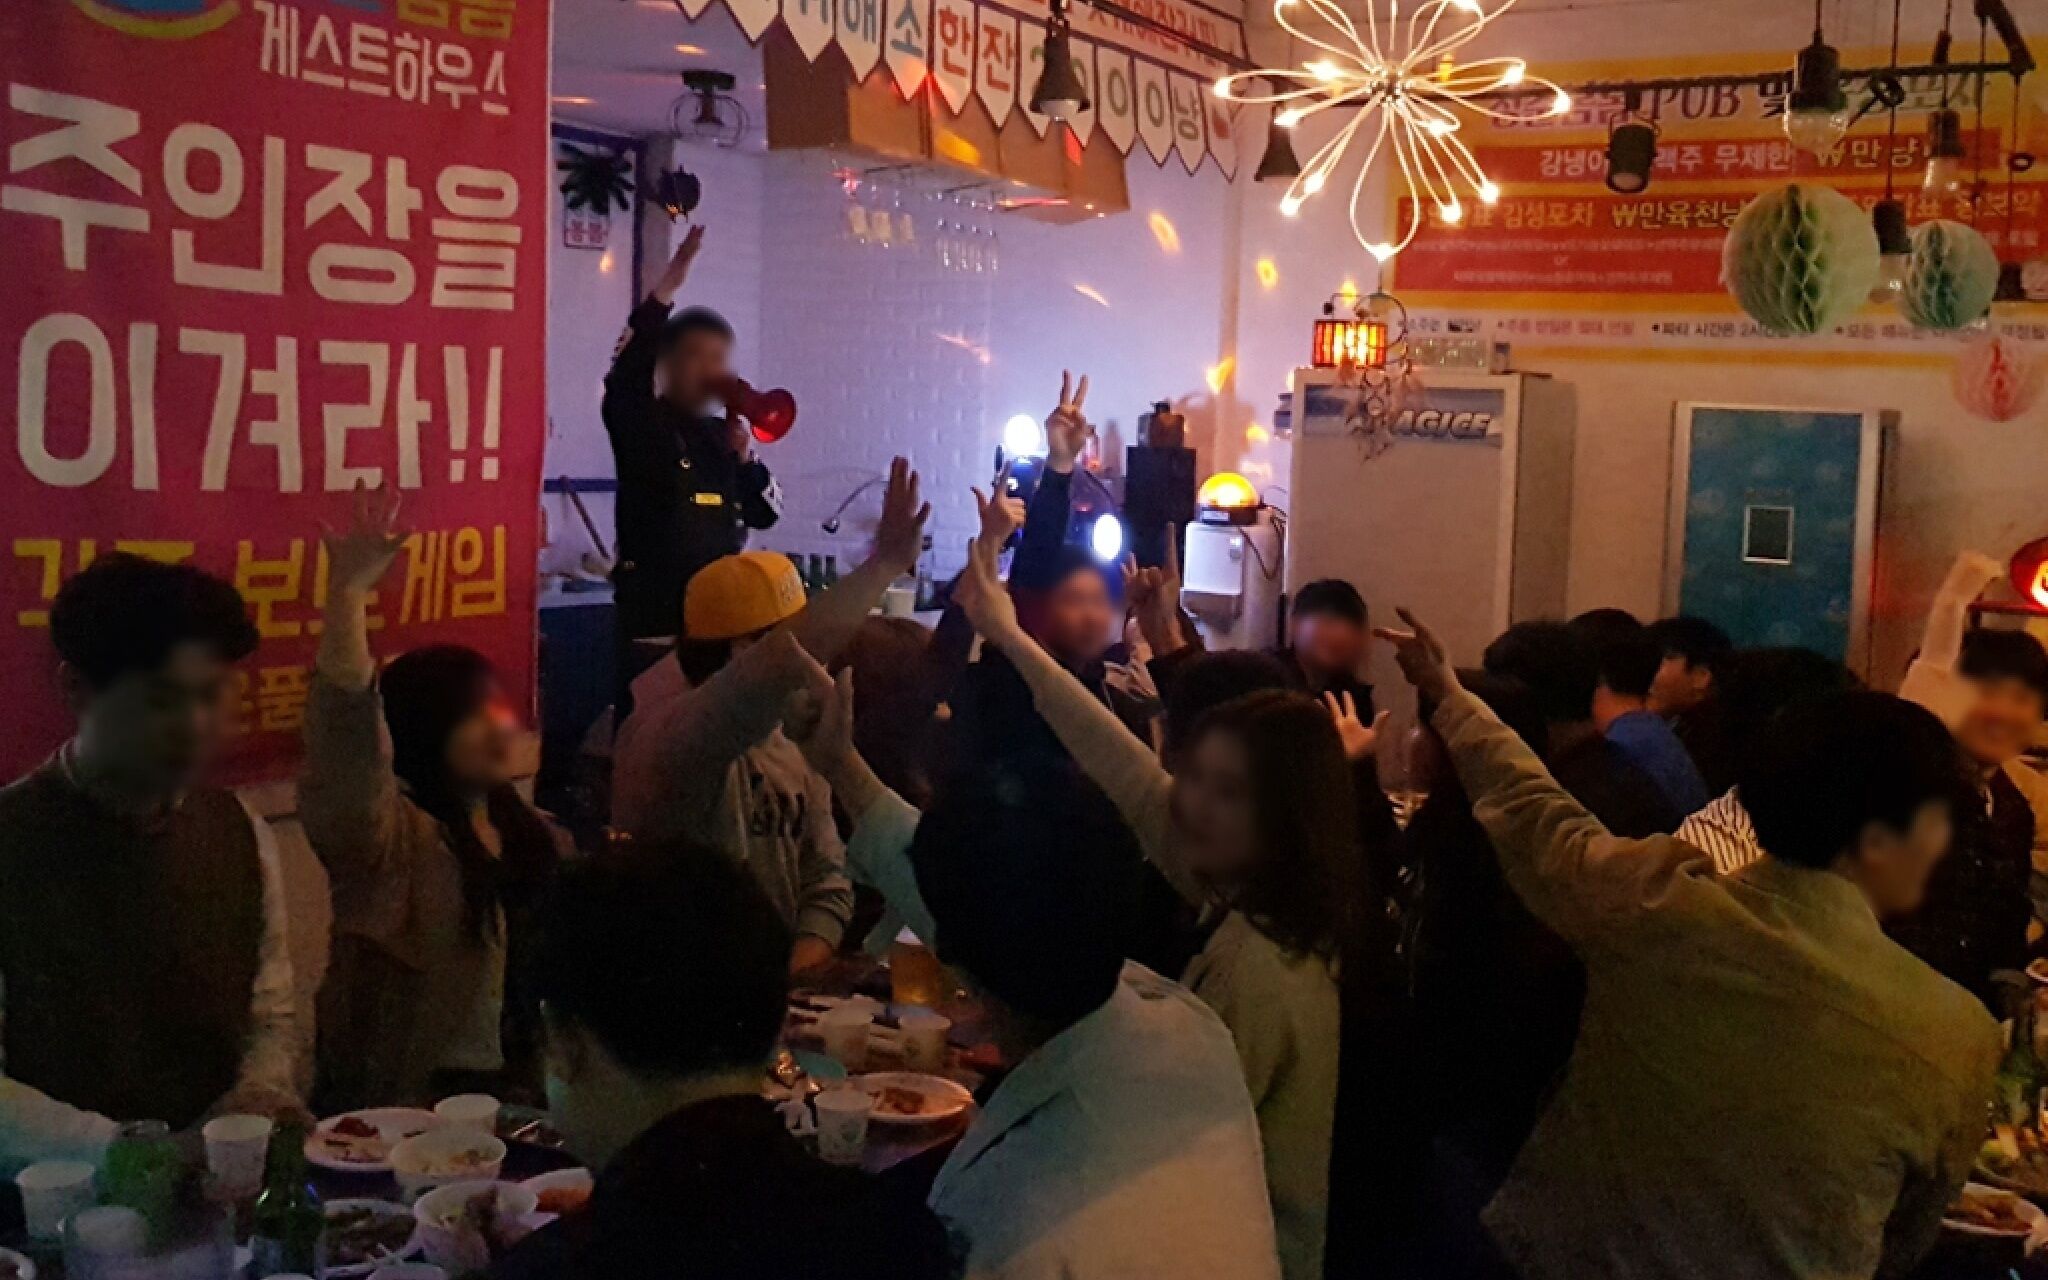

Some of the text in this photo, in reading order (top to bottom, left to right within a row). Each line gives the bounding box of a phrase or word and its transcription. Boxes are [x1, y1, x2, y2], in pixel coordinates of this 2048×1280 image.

[253, 1, 511, 116] 게스트하우스
[938, 7, 1014, 91] 한잔
[1, 83, 521, 310] 주인장을
[1715, 142, 1792, 172] 무제한
[17, 312, 503, 494] 이겨라!!
